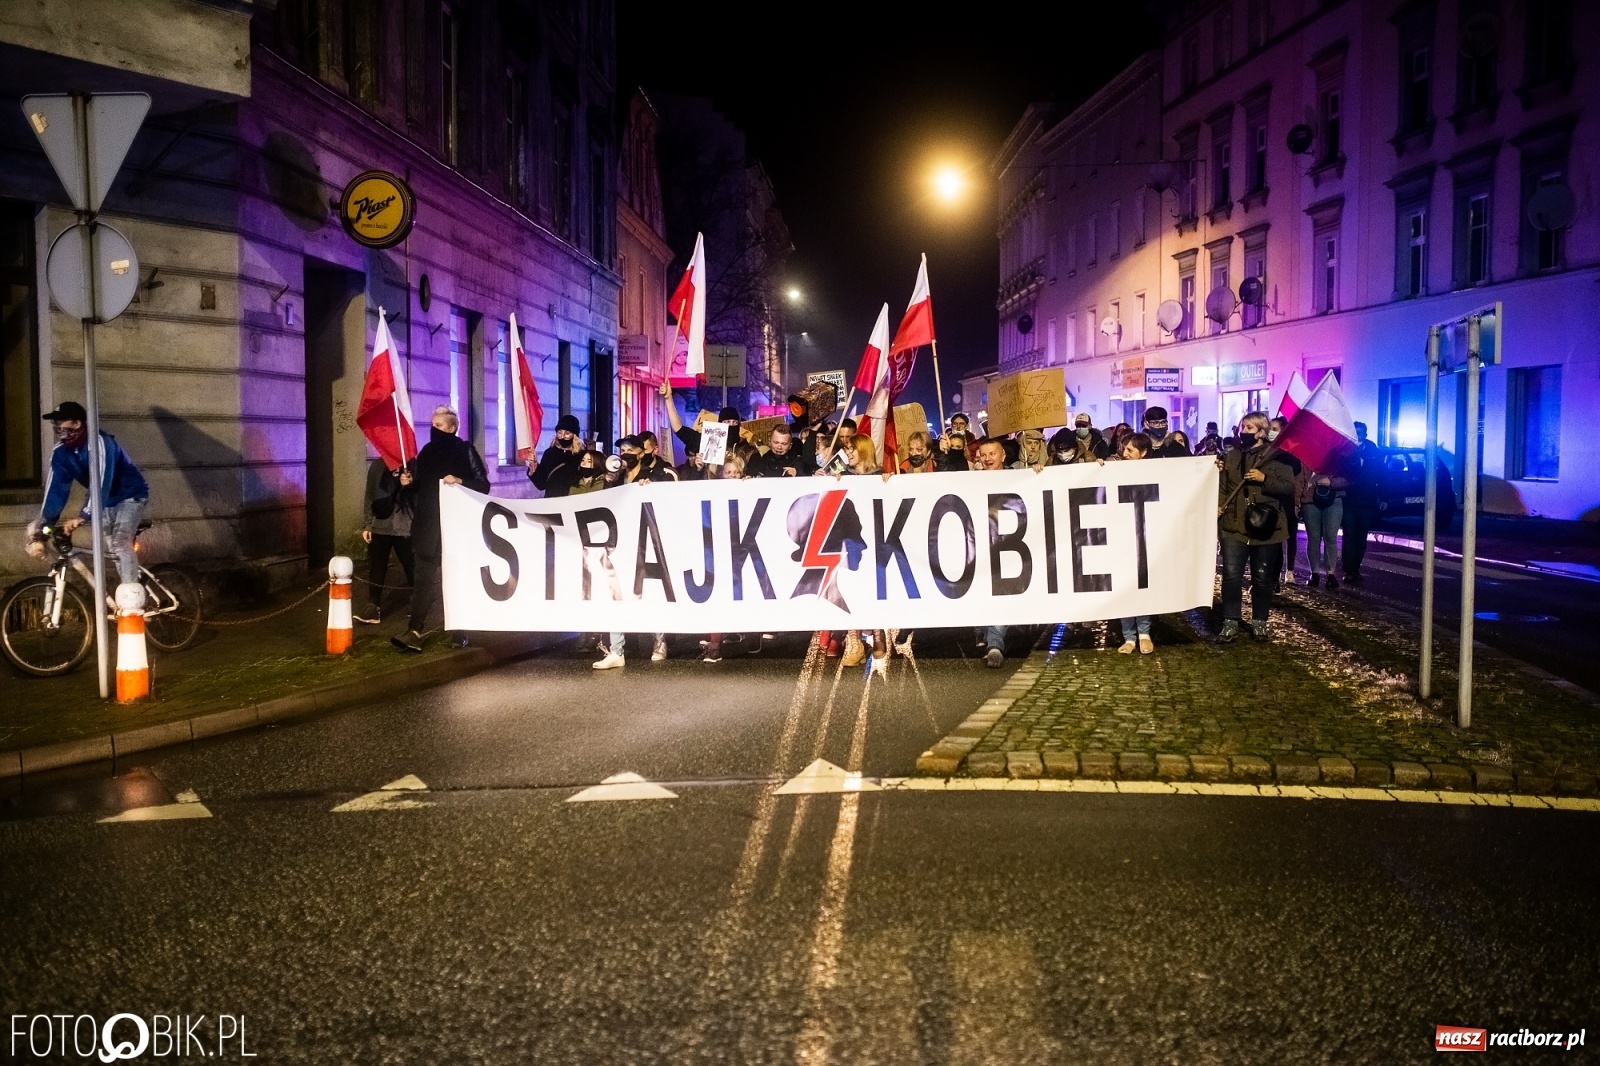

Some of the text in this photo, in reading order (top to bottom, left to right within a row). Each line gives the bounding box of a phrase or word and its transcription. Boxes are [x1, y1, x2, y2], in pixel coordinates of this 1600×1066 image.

[353, 195, 396, 223] Piast
[1240, 363, 1265, 380] OUTLET
[479, 483, 1161, 603] STRAJK KOBIET
